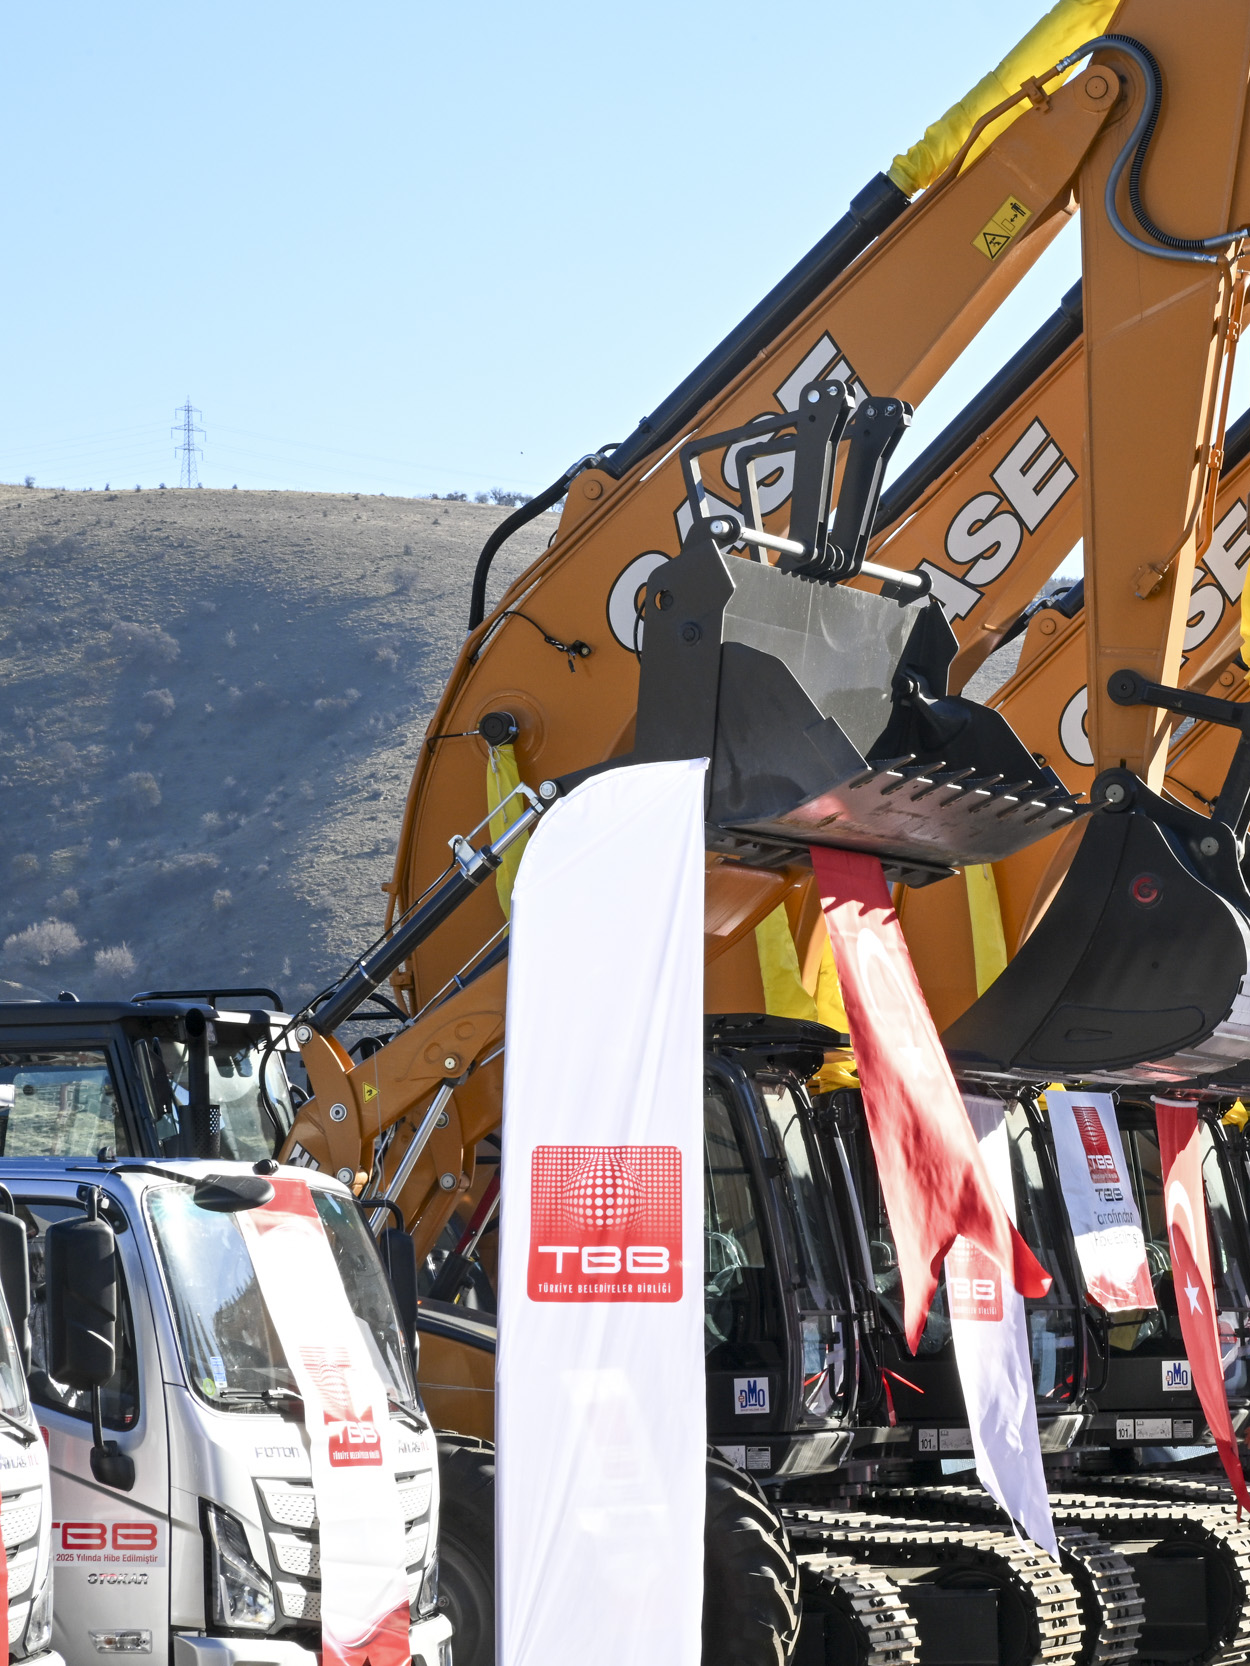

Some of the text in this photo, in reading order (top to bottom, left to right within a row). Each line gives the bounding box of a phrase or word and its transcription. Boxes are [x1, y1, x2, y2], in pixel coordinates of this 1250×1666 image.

[894, 416, 1079, 626] ASE
[1087, 1155, 1115, 1169] TBB
[1095, 1188, 1124, 1202] TBB
[538, 1246, 670, 1274] TBB
[538, 1282, 671, 1293] TÜRKİYE BELEDİYELER BİRLİĞİ
[950, 1278, 996, 1300] BB
[56, 1554, 158, 1564] 2025 Yılında Hibe Edilmiştir
[88, 1573, 149, 1585] OTOKAR
